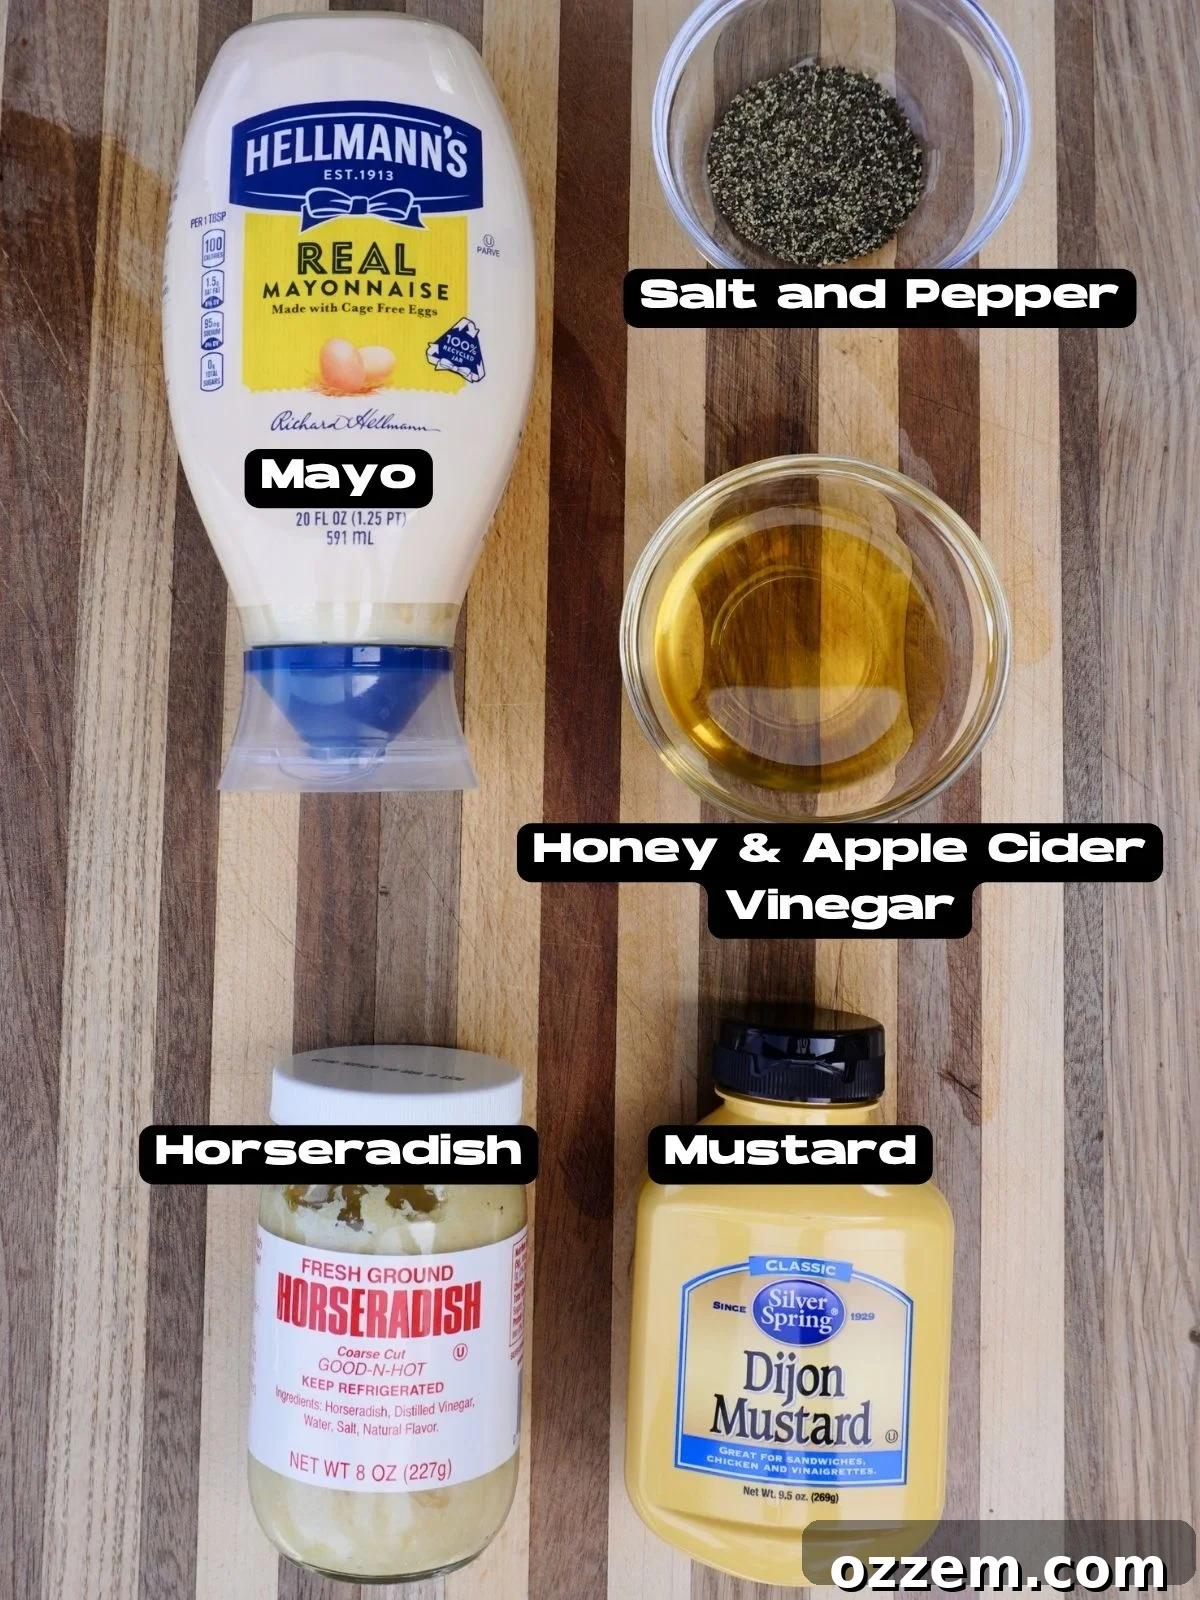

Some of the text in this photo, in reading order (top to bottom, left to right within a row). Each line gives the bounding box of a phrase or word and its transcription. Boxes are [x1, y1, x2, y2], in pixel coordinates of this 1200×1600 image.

[245, 123, 468, 178] HELLMANN'S
[324, 169, 394, 181] EST.1913
[190, 216, 203, 228] PER
[208, 211, 227, 224] TBSP
[205, 236, 222, 253] 100
[477, 246, 500, 258] PARVE
[297, 242, 416, 276] REAL
[262, 279, 449, 301] MAYONNAISE
[272, 302, 438, 318] Made with Cage Free Eggs
[443, 345, 474, 361] RECYCLED
[446, 334, 478, 355] 100%
[203, 377, 220, 387] SUGARS
[270, 408, 440, 432] Richard Hellmann
[296, 511, 406, 528] 20 FL OZ (1.25 PT)
[327, 530, 374, 545] 591 mL
[302, 1258, 454, 1284] FRESH GROUND
[766, 1260, 836, 1276] CLASSIC
[276, 1272, 482, 1339] HORSERADISH
[713, 1302, 746, 1313] SINCE
[769, 1289, 827, 1310] Silver
[850, 1312, 875, 1321] 1929
[337, 1346, 406, 1360] Coarse Cut
[318, 1358, 427, 1377] GOOD-N-HOT
[302, 1376, 444, 1396] KEEP REFRIGERATED
[744, 1350, 844, 1406] Dijon
[276, 1385, 475, 1419] Ingredients: Horseradish, Distilled Vinegar,
[336, 1420, 359, 1436] Salt,
[363, 1423, 401, 1436] Natural
[405, 1422, 439, 1435] Flavor.
[710, 1394, 872, 1446] Mustard
[719, 1446, 757, 1459] GREAT
[761, 1453, 782, 1462] FOR
[290, 1450, 452, 1485] NET WT 8 OZ (227g)
[706, 1455, 876, 1476] CHICKEN AND VINAIGRETTES.
[743, 1486, 839, 1504] Net Wt. 9.5 oz. (269g)
